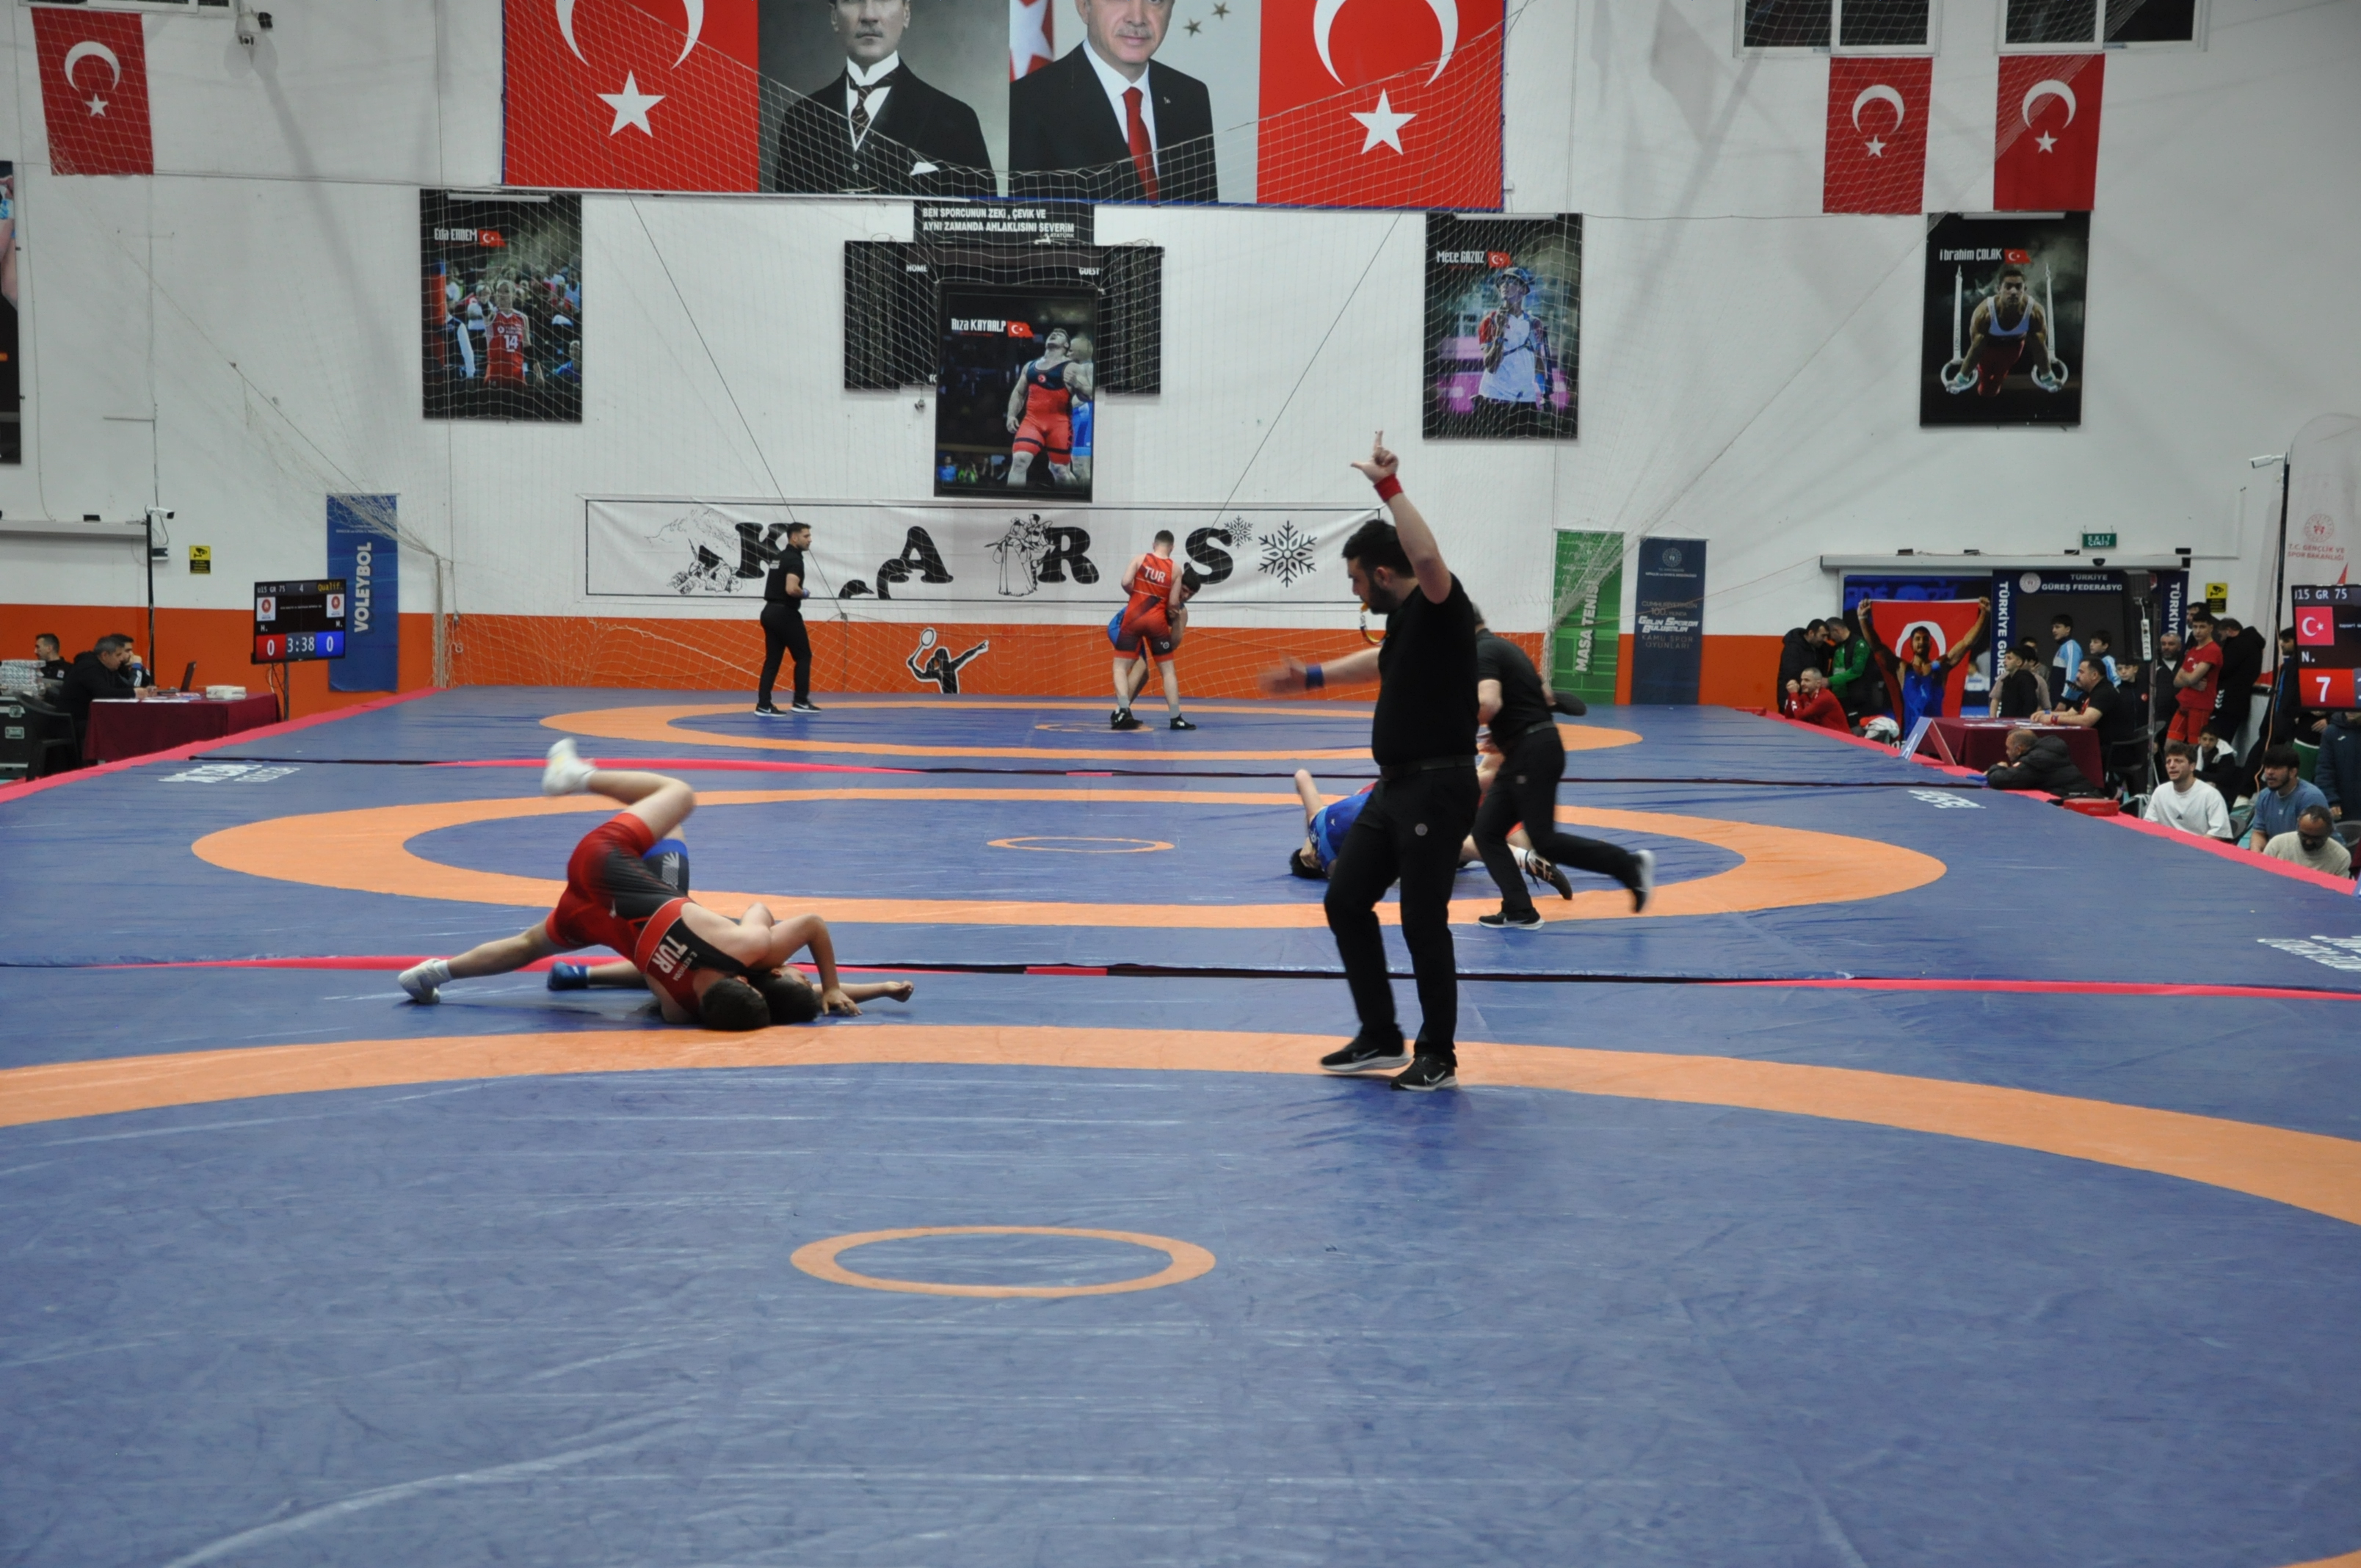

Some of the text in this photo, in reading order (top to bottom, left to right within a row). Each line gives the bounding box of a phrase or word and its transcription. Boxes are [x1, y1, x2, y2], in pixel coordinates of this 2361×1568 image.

[922, 208, 938, 217] BEN
[940, 208, 987, 218] SPORCUNUN
[1036, 209, 1046, 219] VE
[923, 222, 942, 231] AYNI
[944, 222, 984, 231] ZAMANDA
[986, 222, 1037, 232] AHLAKLISINI
[907, 264, 927, 272] HOME
[1079, 267, 1100, 275] GUEST
[504, 335, 518, 349] 14
[1145, 566, 1166, 584] TUR
[299, 584, 304, 592] 4
[354, 542, 371, 633] VOLEYBOL
[2042, 583, 2070, 592] GÜREŞ
[2315, 589, 2329, 600] GR
[2335, 588, 2348, 600] 75
[1998, 581, 2010, 637] TÜRKİYE
[267, 639, 275, 656] 0
[287, 636, 315, 653] 3:38
[326, 636, 334, 653] 0
[1575, 630, 1593, 672] MASA
[2302, 651, 2315, 663] N.
[2315, 676, 2332, 703] 7
[651, 935, 689, 974] TUR
